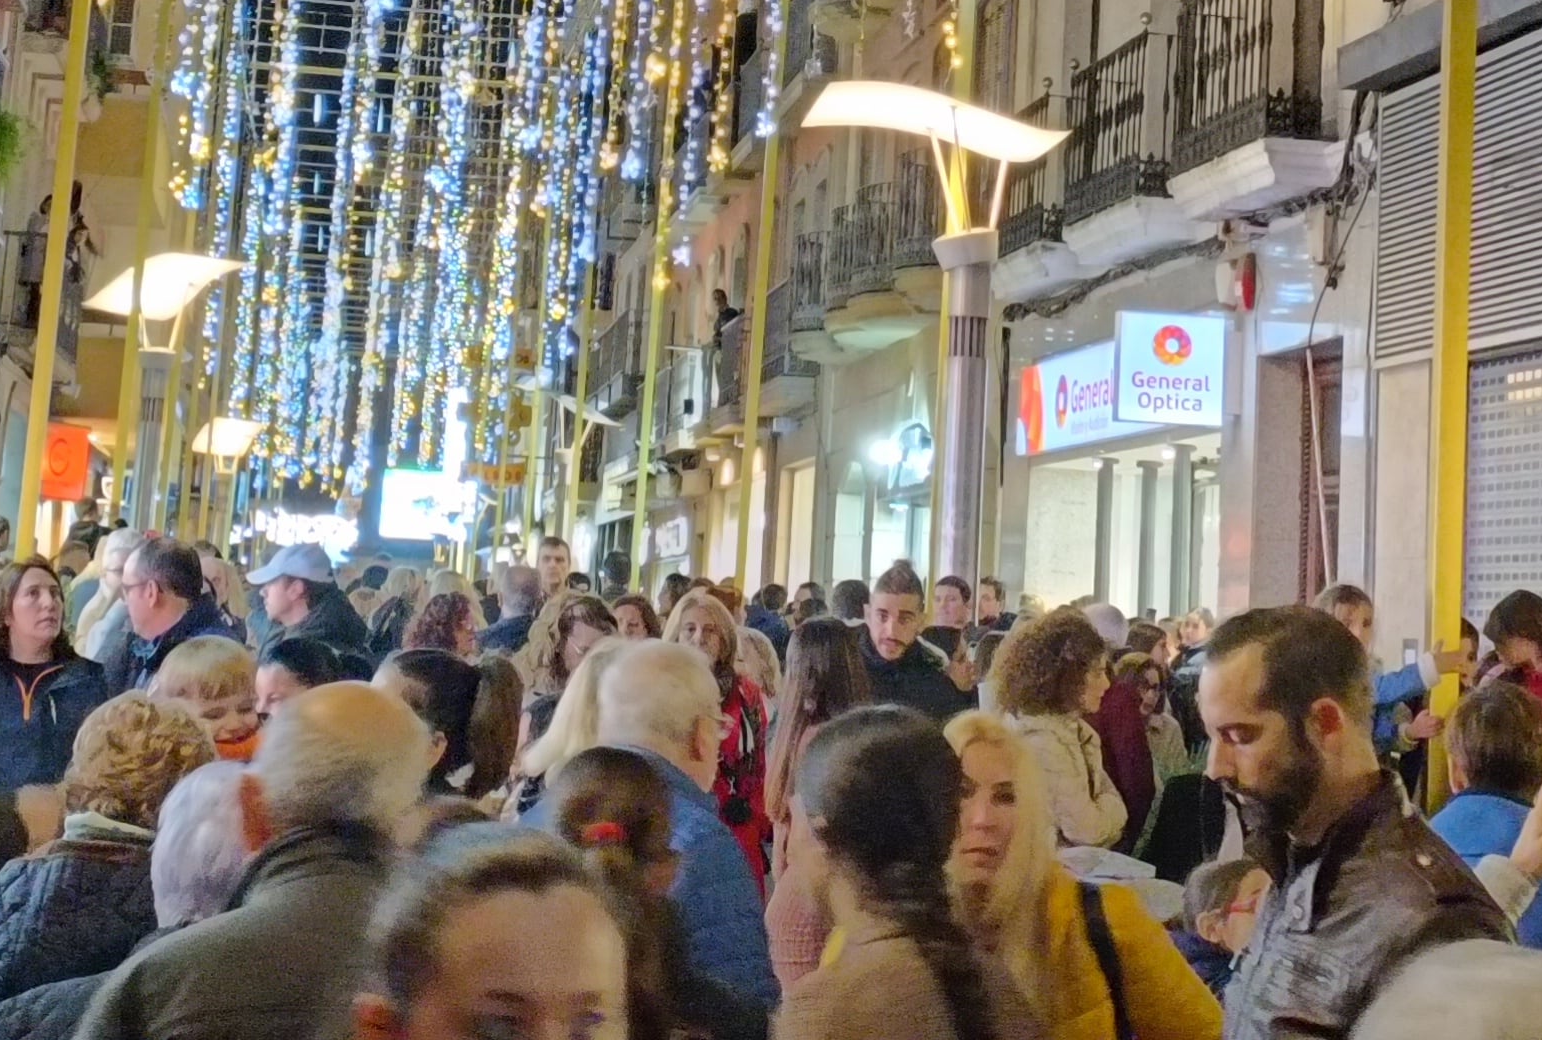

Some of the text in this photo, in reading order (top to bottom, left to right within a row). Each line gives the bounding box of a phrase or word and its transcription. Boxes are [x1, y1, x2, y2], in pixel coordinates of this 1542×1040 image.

[1071, 368, 1115, 414] General
[1131, 370, 1211, 392] General
[1137, 391, 1203, 414] Optica
